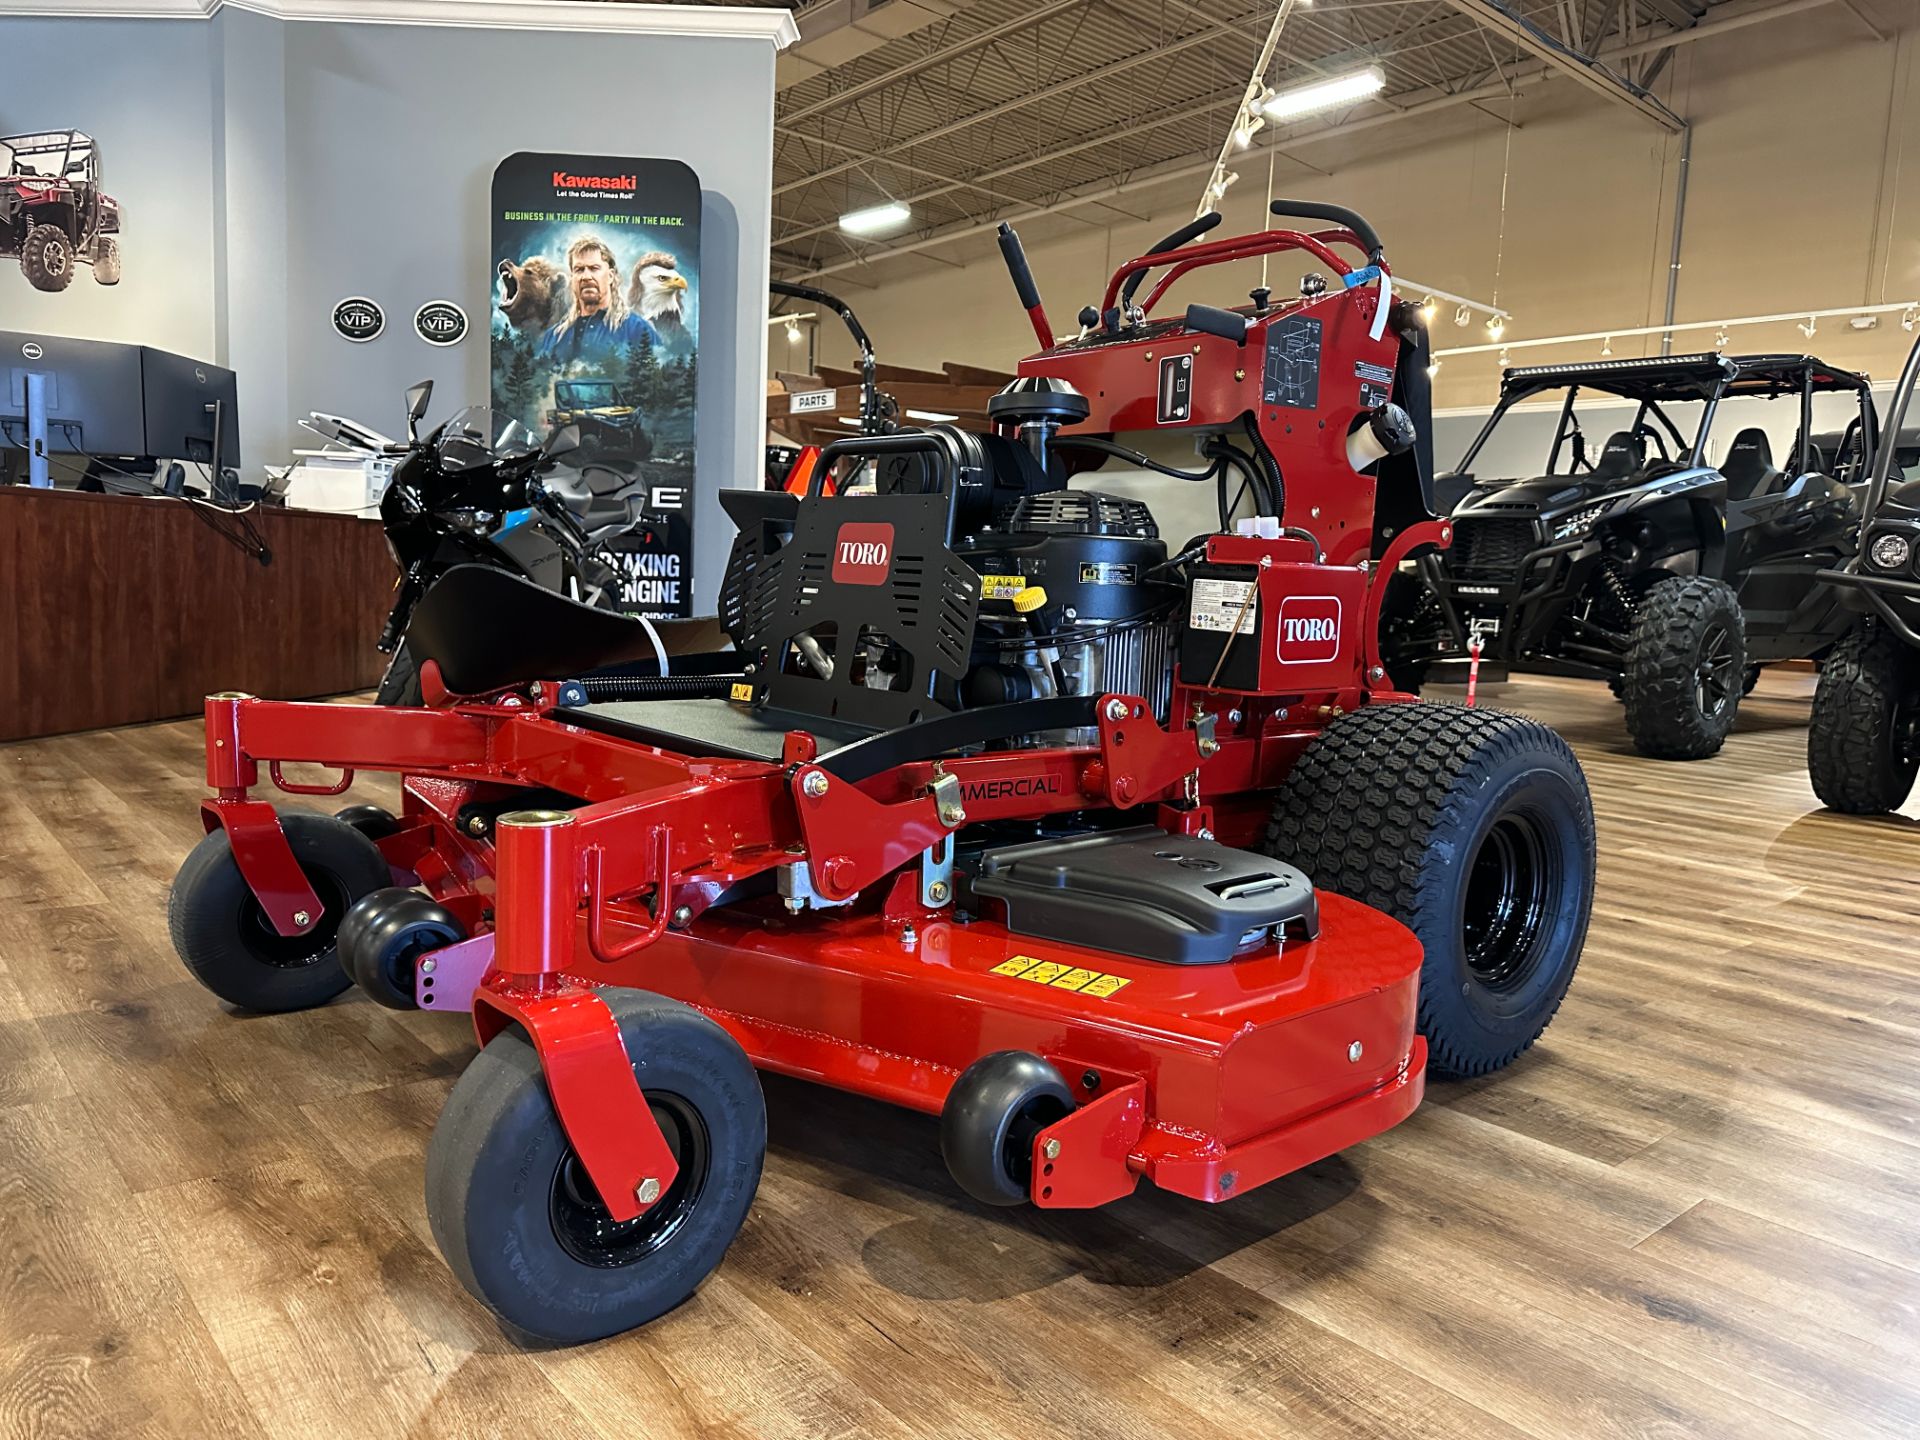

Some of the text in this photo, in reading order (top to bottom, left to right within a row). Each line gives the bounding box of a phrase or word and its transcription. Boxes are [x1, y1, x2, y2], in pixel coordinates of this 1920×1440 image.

[553, 171, 636, 190] Kawasaki
[568, 190, 579, 198] the
[599, 191, 619, 199] Times
[504, 211, 685, 226] BUSINESS IN THE FRONT. PARTY IN THE BACK.
[344, 313, 371, 327] VIP
[427, 317, 454, 331] VIP
[799, 395, 827, 408] PARTS
[839, 542, 887, 566] TORO
[1284, 618, 1337, 642] TORO
